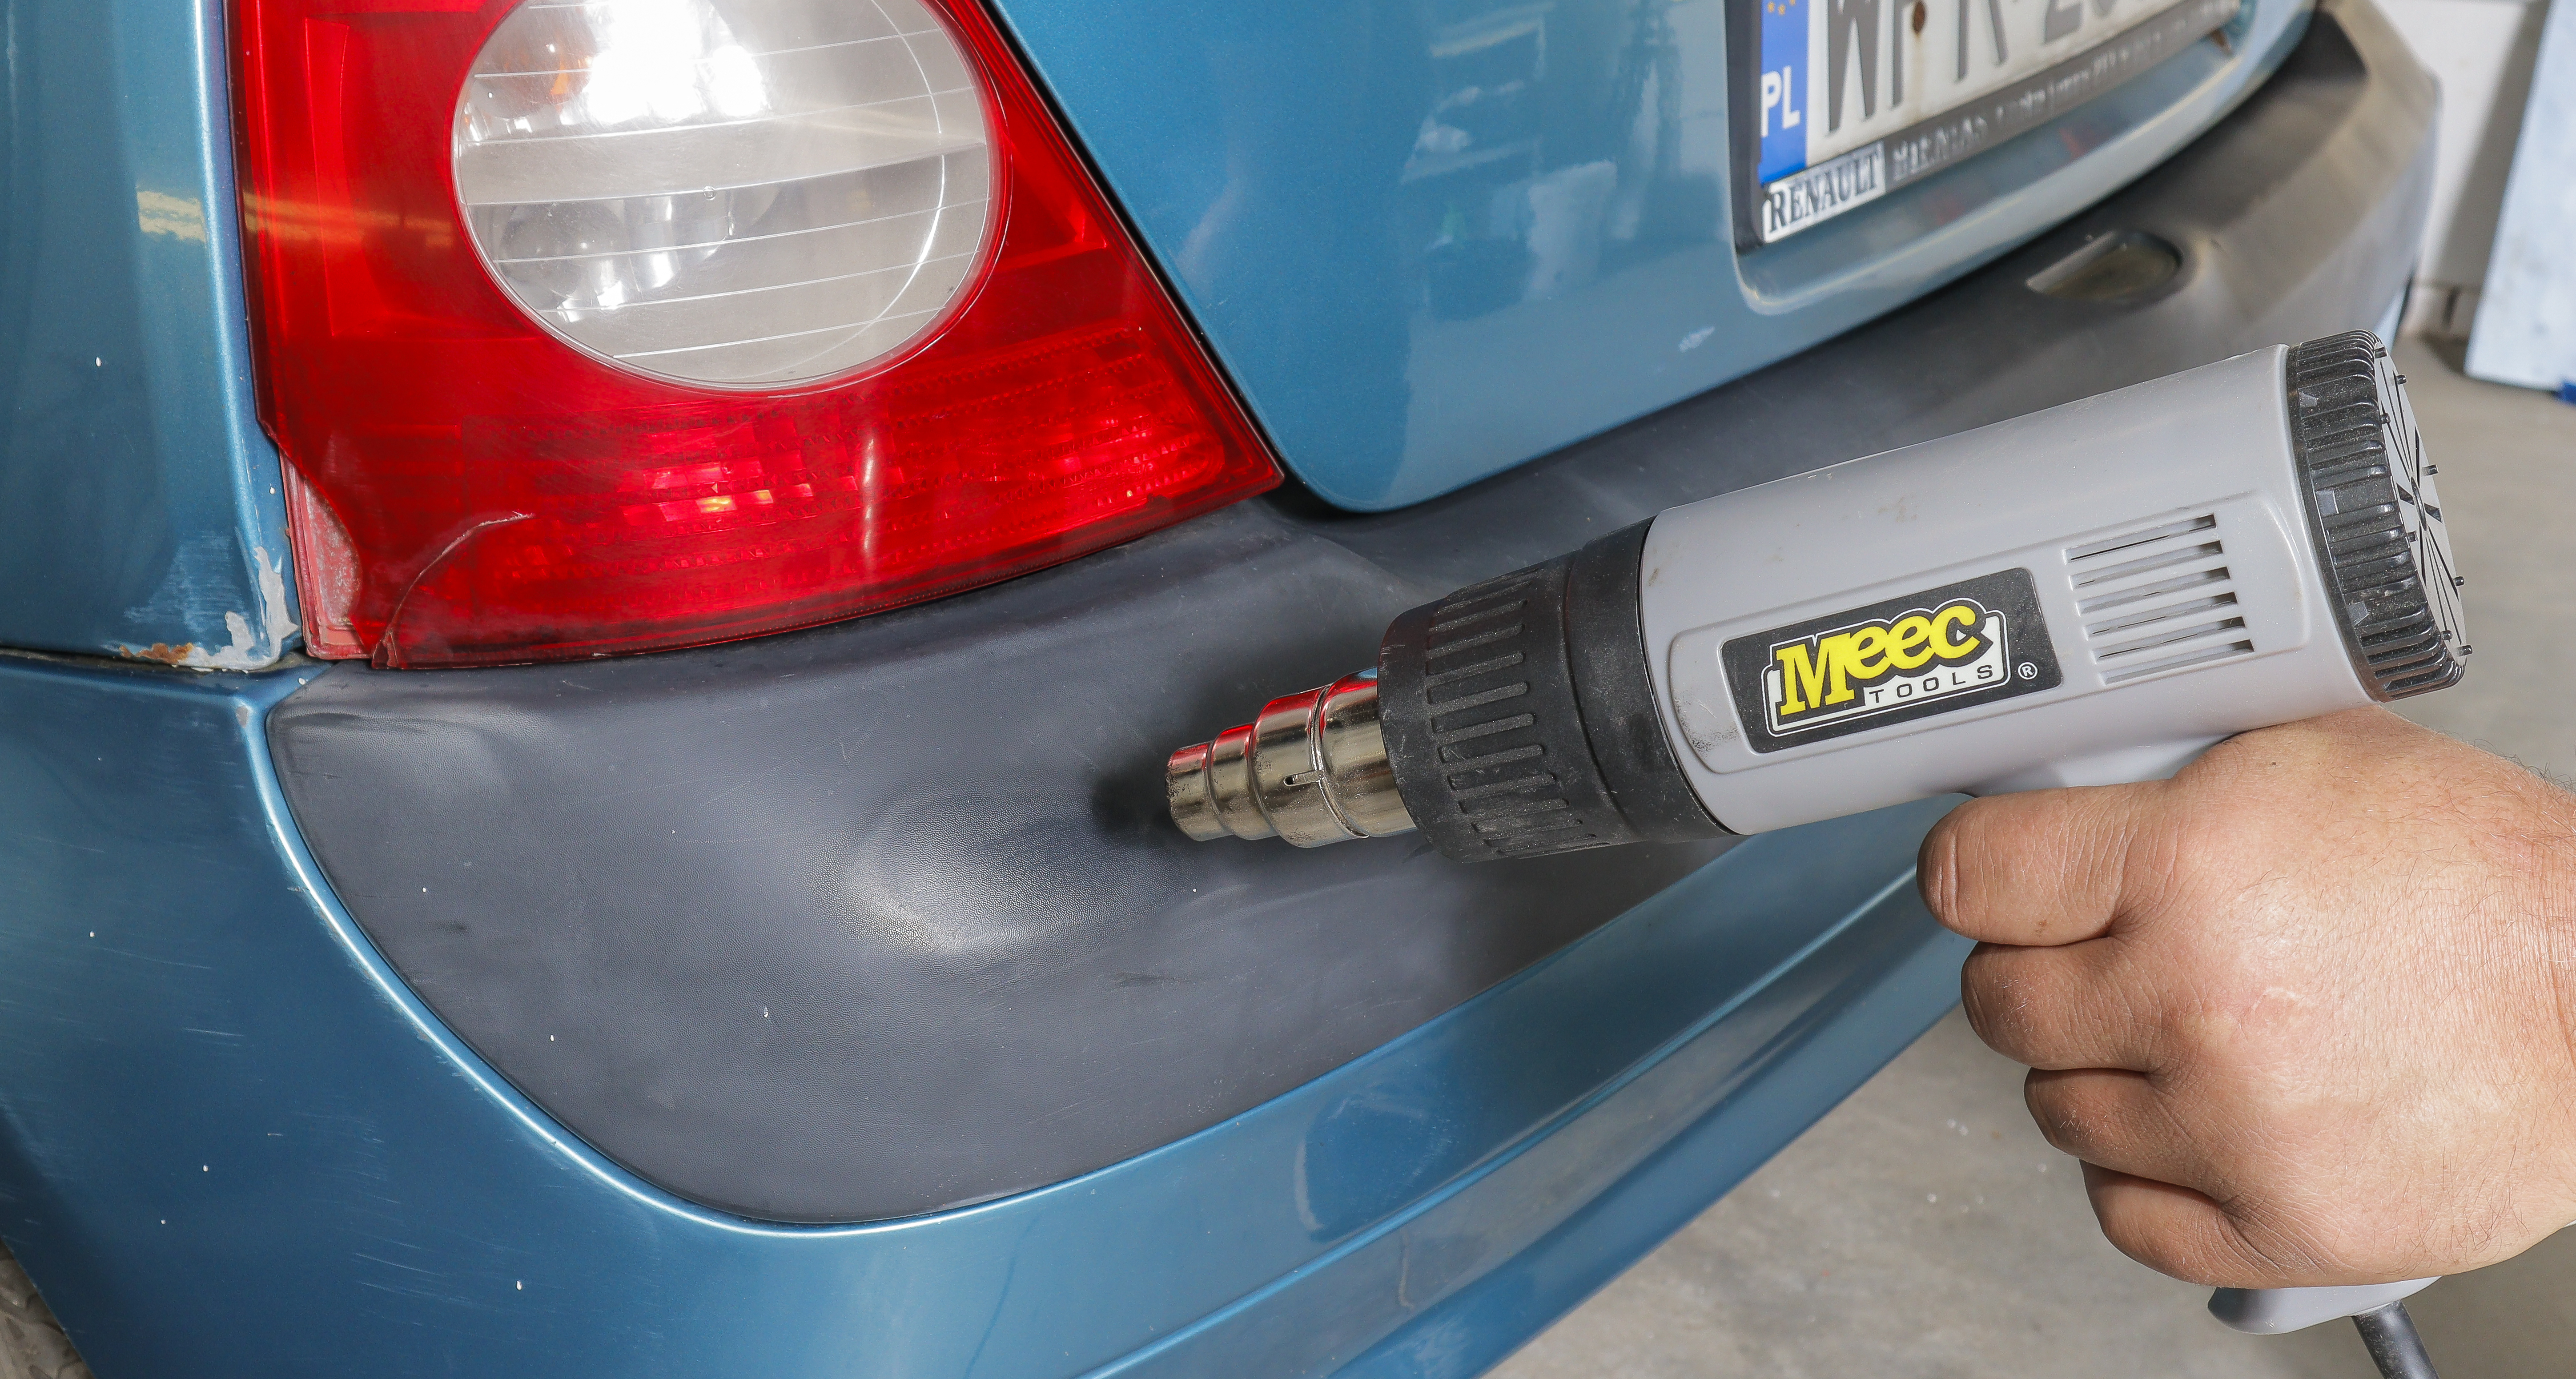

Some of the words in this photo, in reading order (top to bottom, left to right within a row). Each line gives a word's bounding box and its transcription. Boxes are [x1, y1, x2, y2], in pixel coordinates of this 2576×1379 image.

[1761, 65, 1800, 137] PL
[1766, 151, 1877, 233] RENAULT
[1868, 664, 1993, 704] TOOLS
